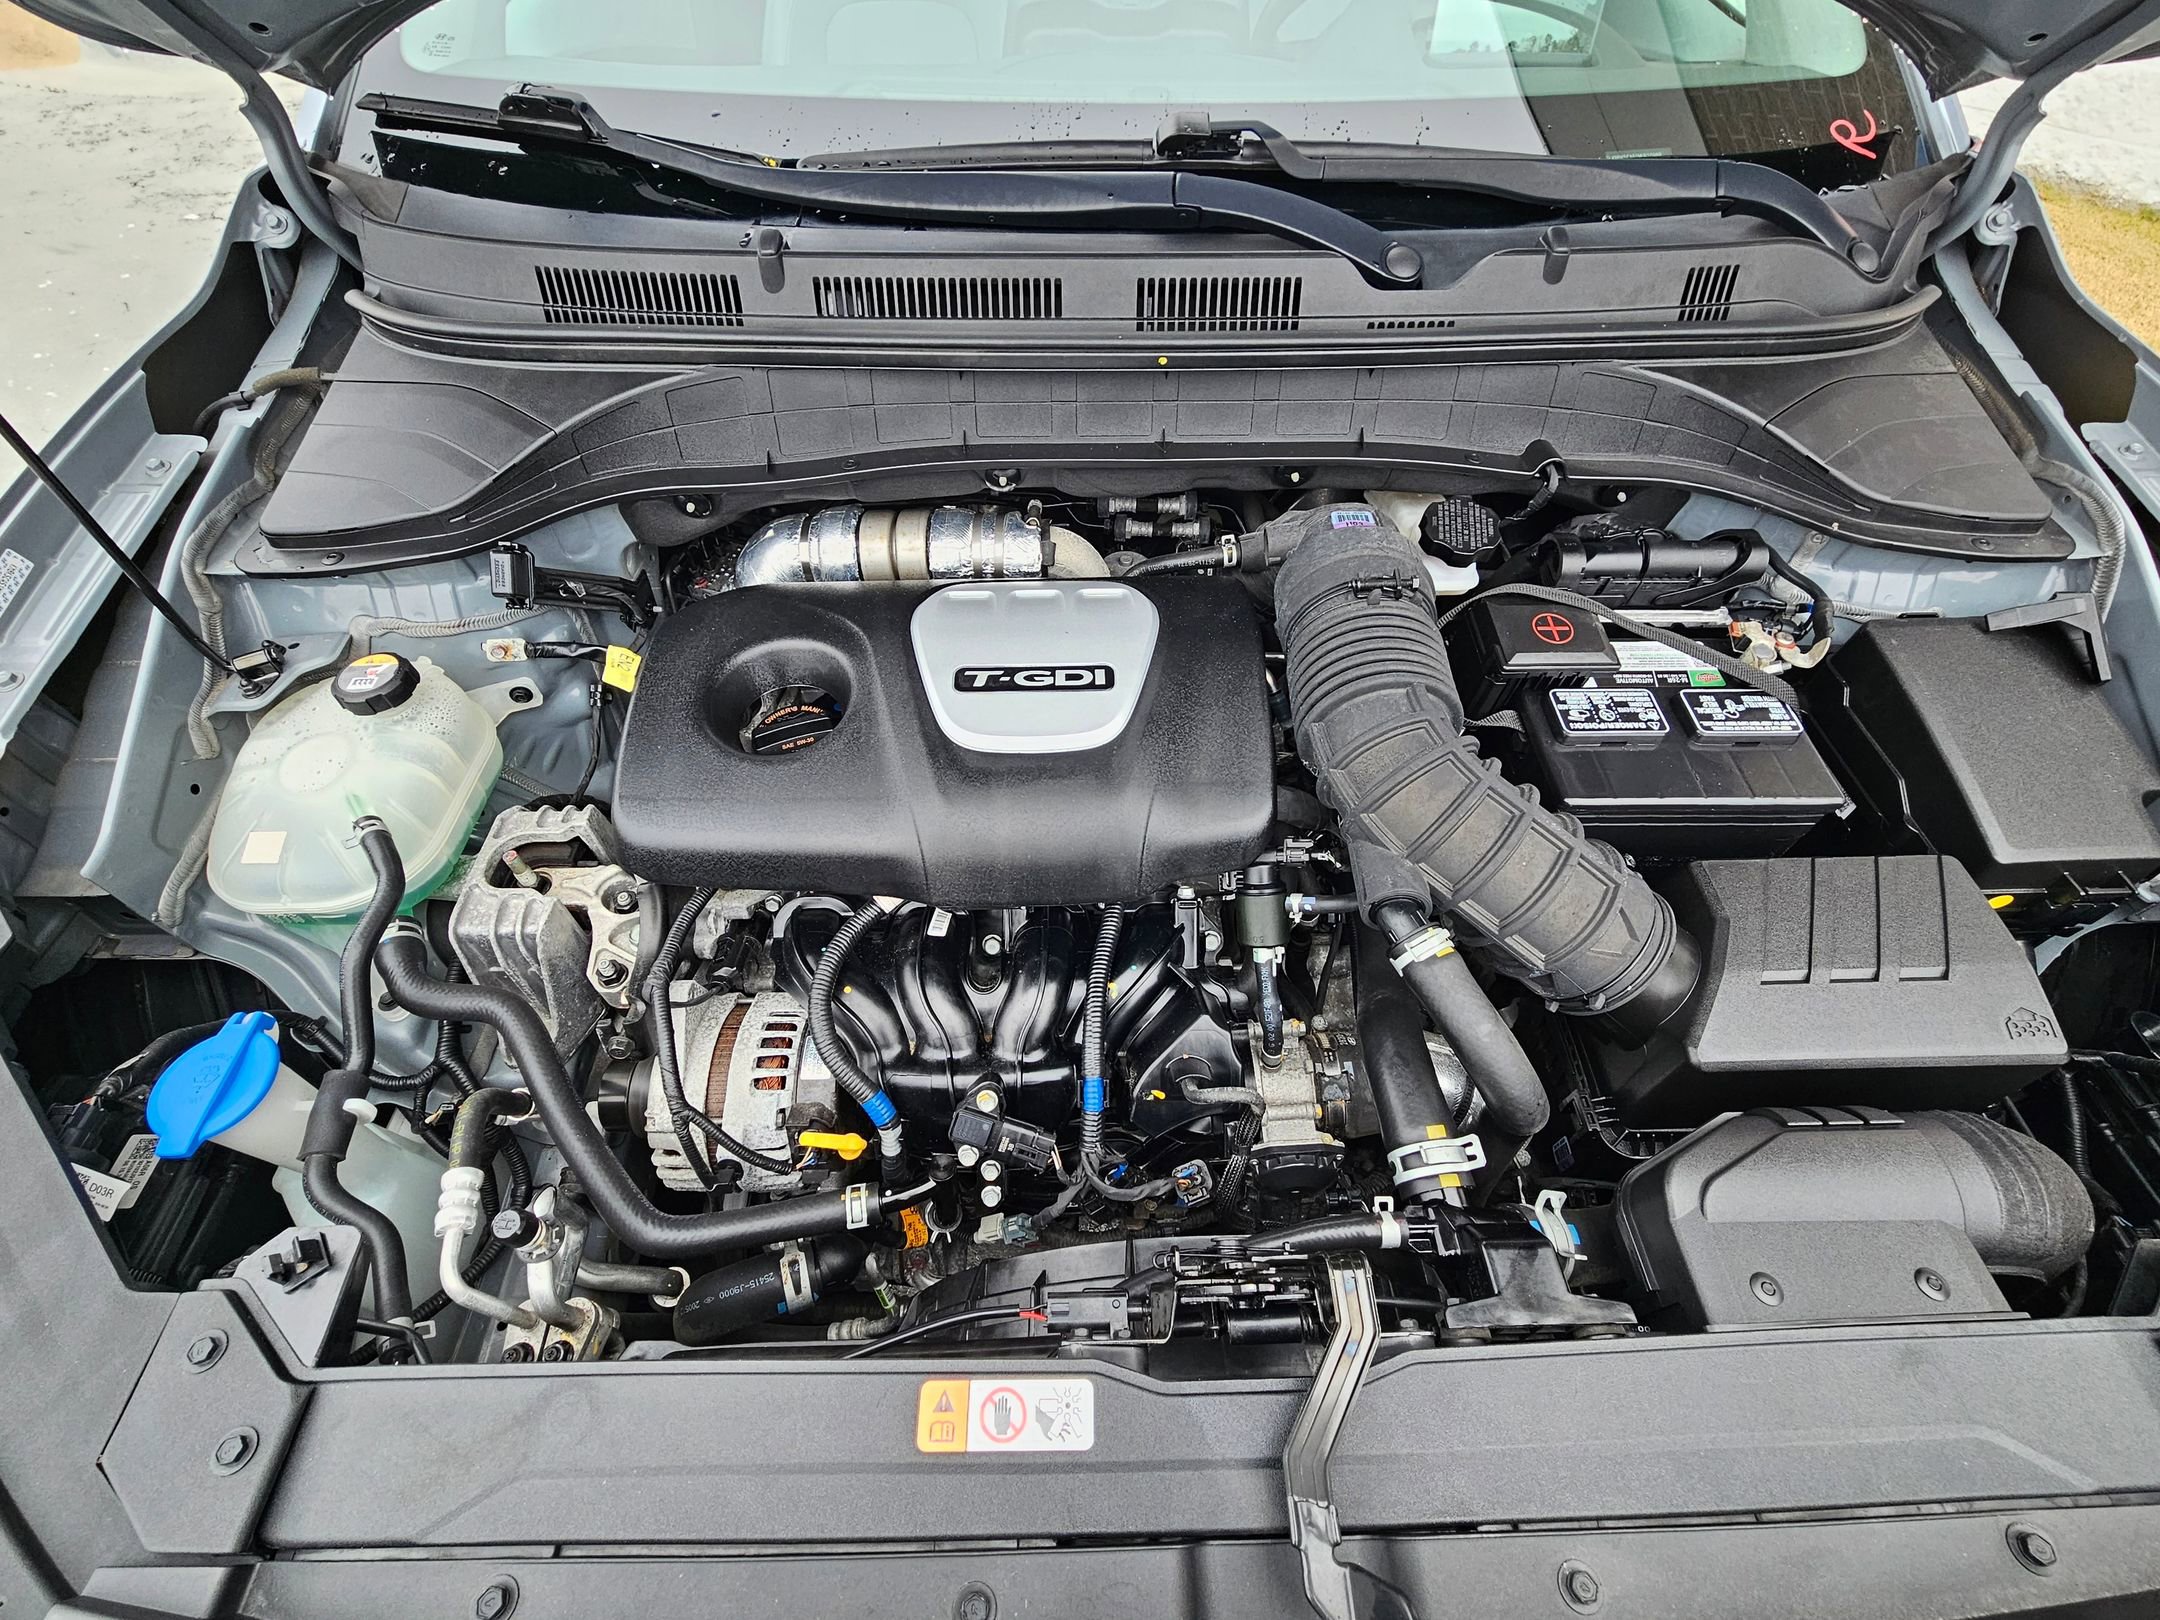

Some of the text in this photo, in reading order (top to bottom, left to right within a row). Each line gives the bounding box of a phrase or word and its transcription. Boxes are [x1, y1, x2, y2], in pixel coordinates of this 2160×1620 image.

[1830, 110, 1876, 159] R
[964, 669, 1107, 687] T-GDI
[764, 705, 798, 724] OWNER'S
[781, 742, 795, 750] SAE
[89, 1182, 115, 1199] D03R
[719, 1272, 775, 1299] 25415-J9000
